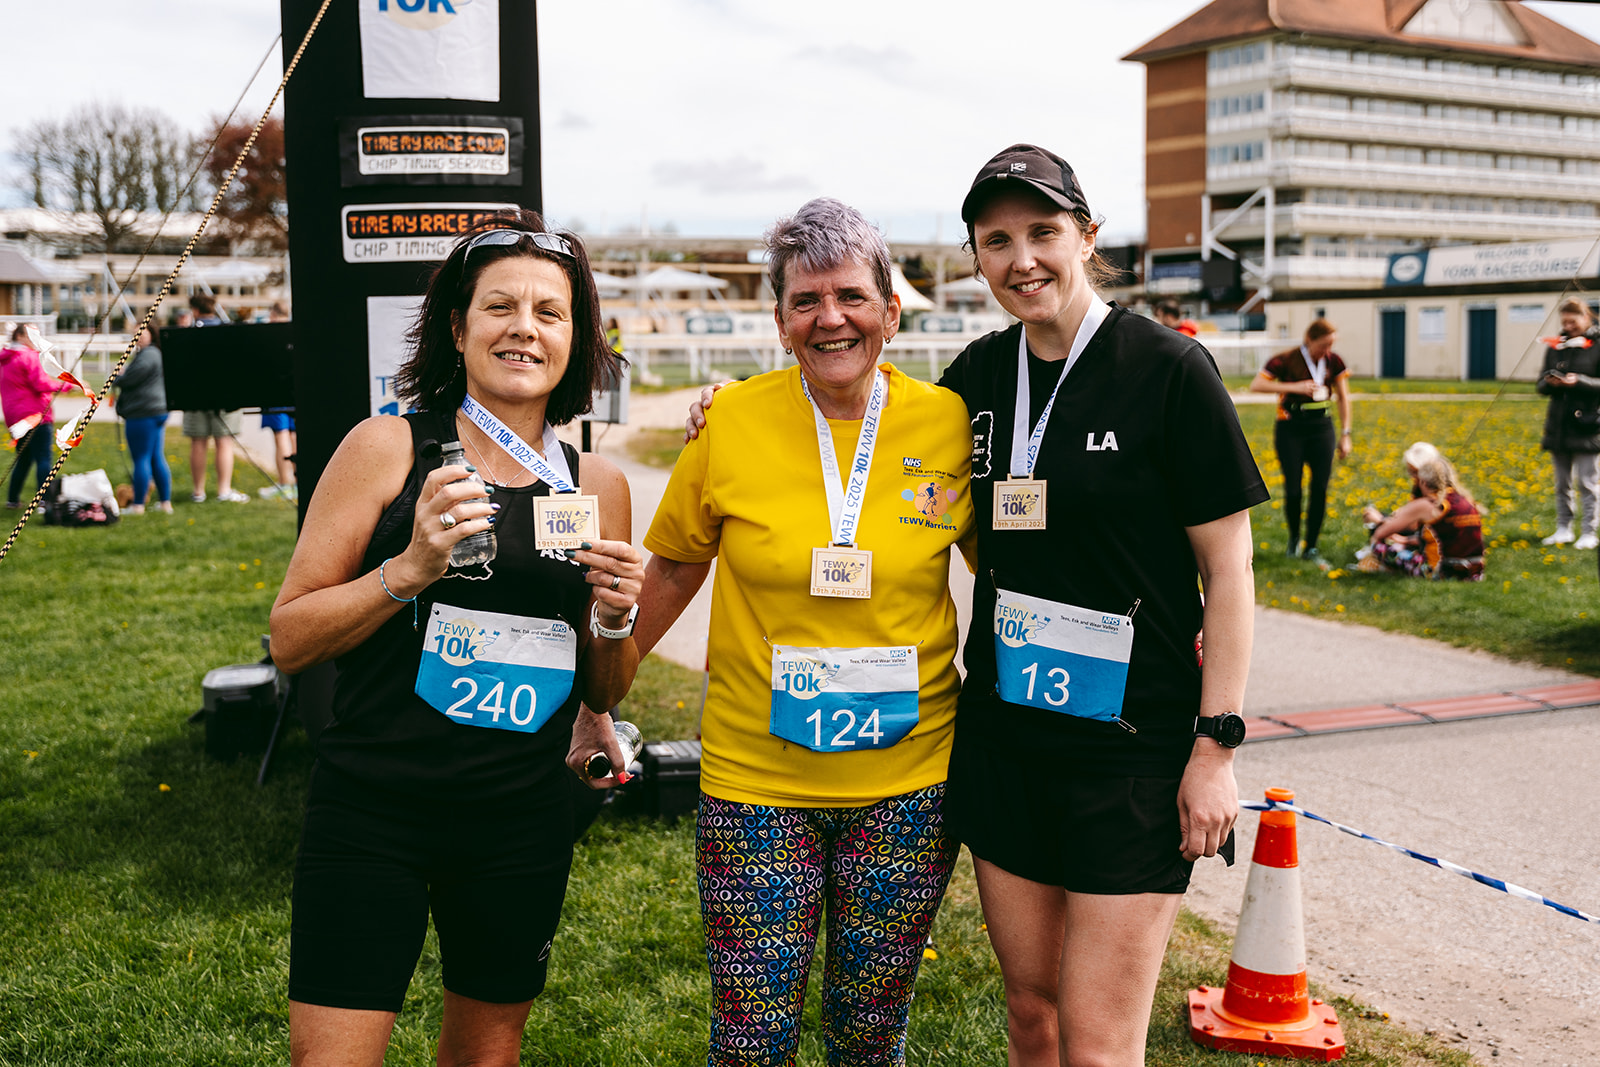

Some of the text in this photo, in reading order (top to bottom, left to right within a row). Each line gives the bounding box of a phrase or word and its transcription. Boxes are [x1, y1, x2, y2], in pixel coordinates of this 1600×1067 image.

[367, 157, 505, 171] CHIP TIMING SERVICES
[354, 240, 447, 258] CHIP TIMING
[1474, 244, 1548, 259] WELCOME TO
[1442, 257, 1580, 279] YORK RACECOURSE
[870, 381, 883, 411] 2025
[861, 415, 877, 451] TEWV
[1086, 431, 1119, 451] LA
[474, 408, 501, 434] TEWV
[496, 428, 514, 447] 10k
[510, 442, 535, 464] 2025
[530, 459, 557, 484] TEWV
[854, 452, 869, 475] 10k
[903, 457, 921, 468] NHS
[846, 477, 864, 509] 2025
[1002, 493, 1024, 502] TEWV
[545, 510, 573, 519] TEWV
[1002, 501, 1027, 515] 10k
[546, 518, 578, 534] 10k
[898, 516, 957, 531] TEWV Harriers
[1010, 521, 1027, 529] April
[558, 540, 578, 548] April
[823, 560, 848, 569] TEWV
[822, 569, 851, 583] 10k
[831, 588, 850, 596] April
[998, 604, 1028, 620] TEWV
[436, 620, 476, 638] TEWV
[552, 624, 567, 633] NHS
[1102, 616, 1120, 626] NHS
[997, 617, 1030, 643] 10k
[434, 634, 478, 660] 10k
[781, 661, 817, 672] TEWV
[781, 672, 821, 692] 10k
[1022, 662, 1071, 707] 13
[445, 677, 537, 726] 240
[806, 709, 884, 747] 124
